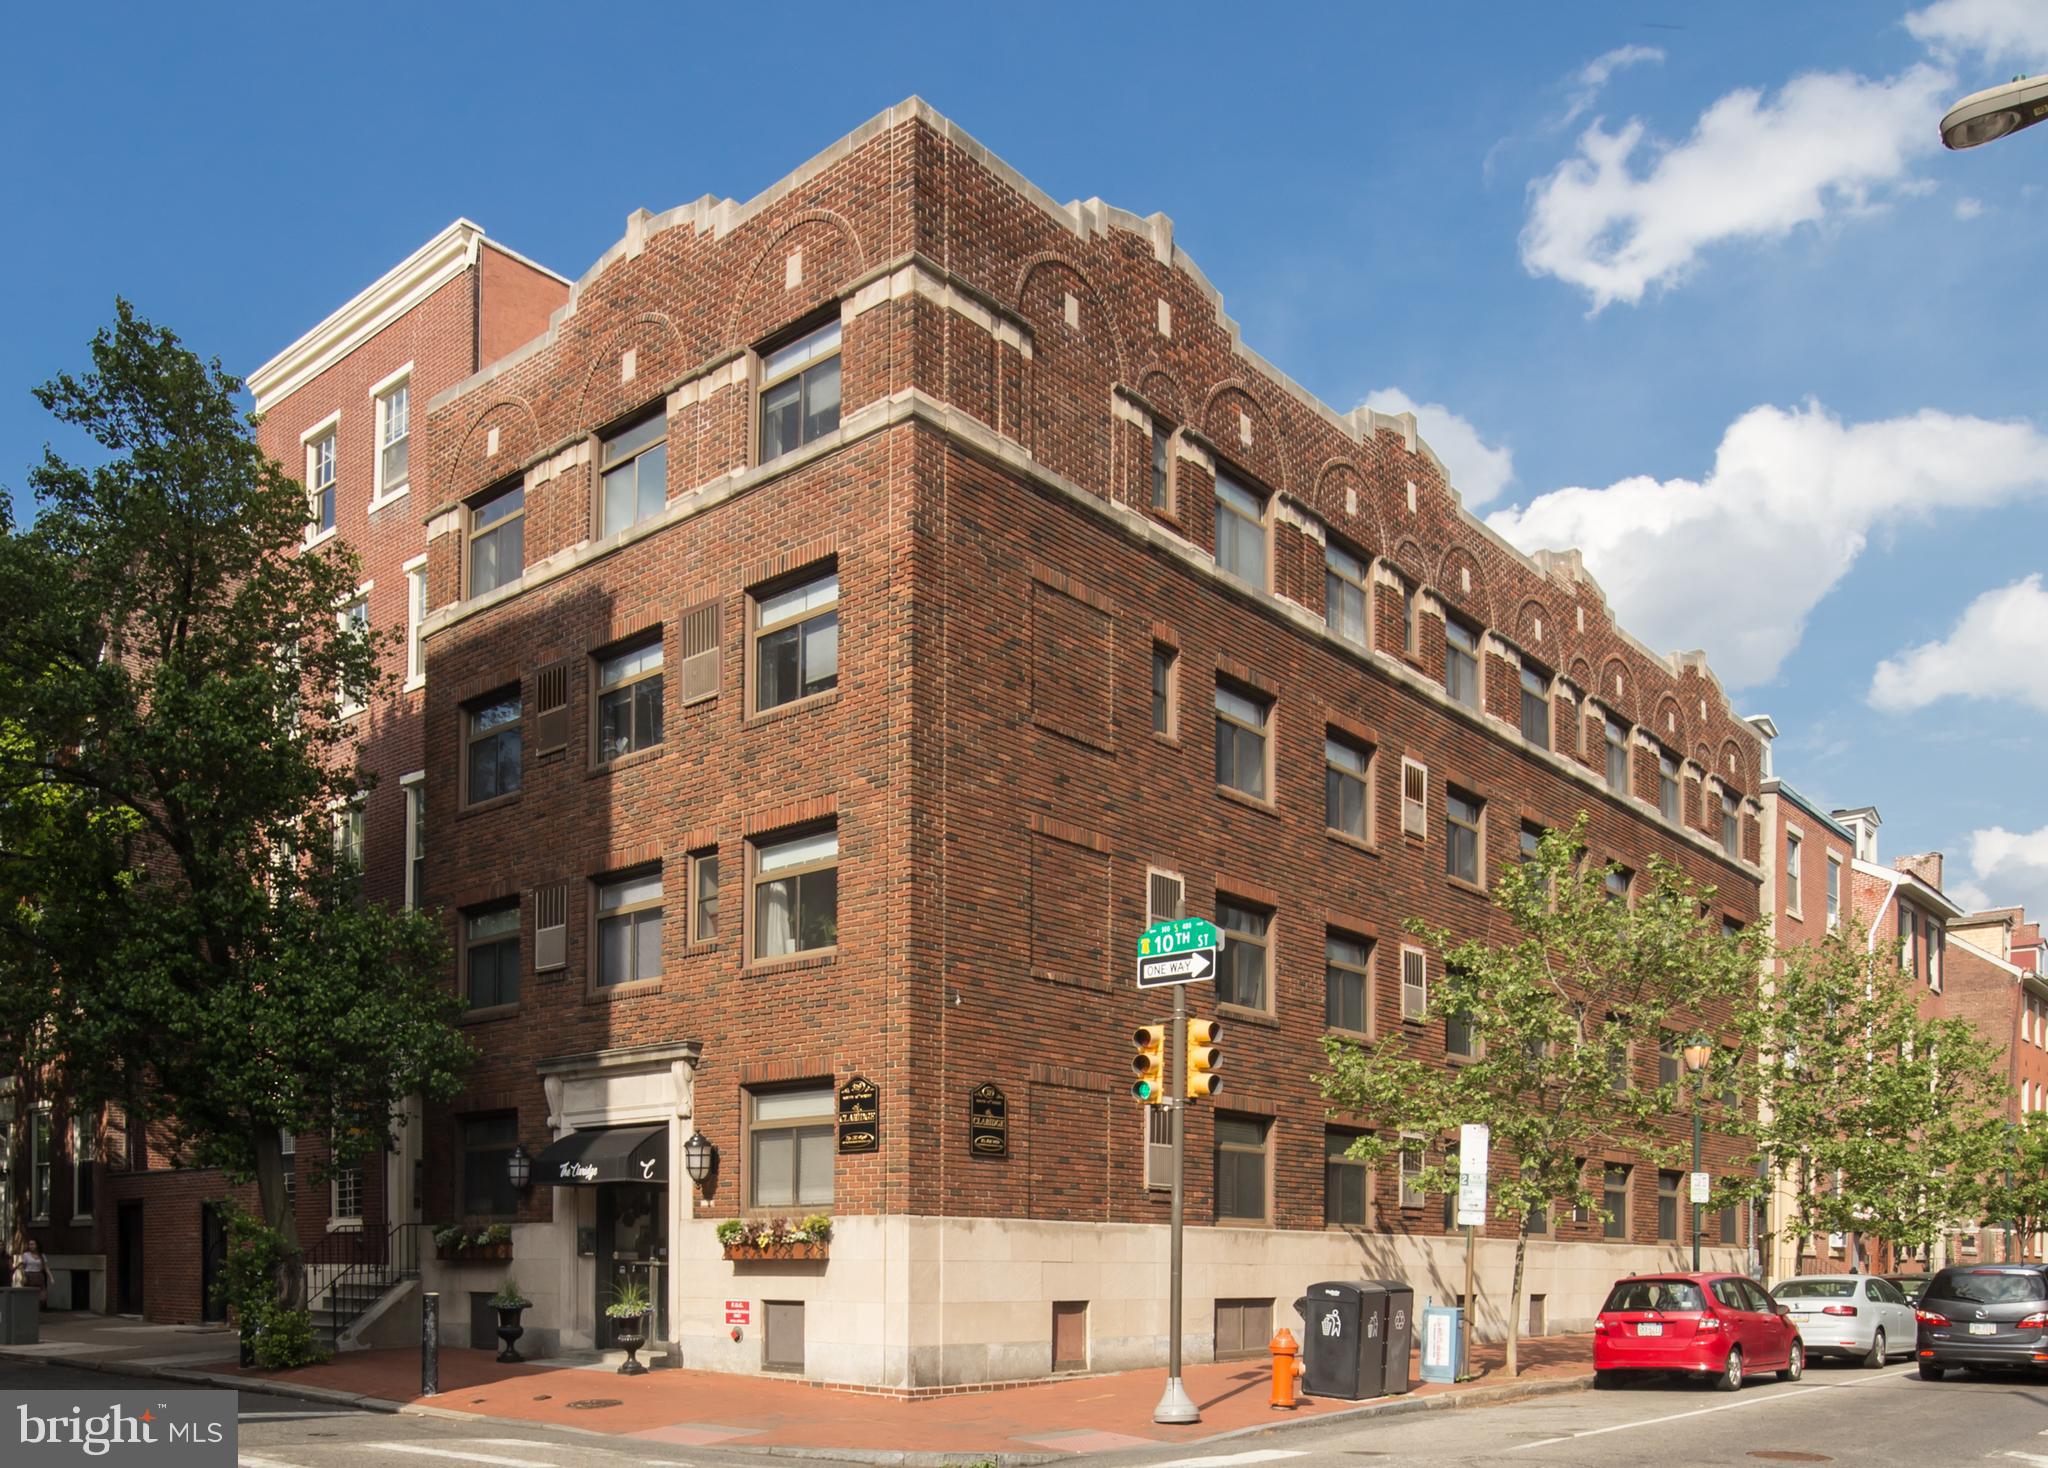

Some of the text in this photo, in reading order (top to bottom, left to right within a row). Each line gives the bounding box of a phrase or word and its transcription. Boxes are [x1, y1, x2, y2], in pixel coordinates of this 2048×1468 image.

[1174, 923, 1179, 933] S
[1154, 931, 1209, 953] 10TH ST
[1146, 959, 1192, 977] ONE WAY
[839, 1111, 876, 1123] CLARIDGE
[973, 1116, 1005, 1128] CLARIDGE
[559, 1161, 598, 1181] The Claridge
